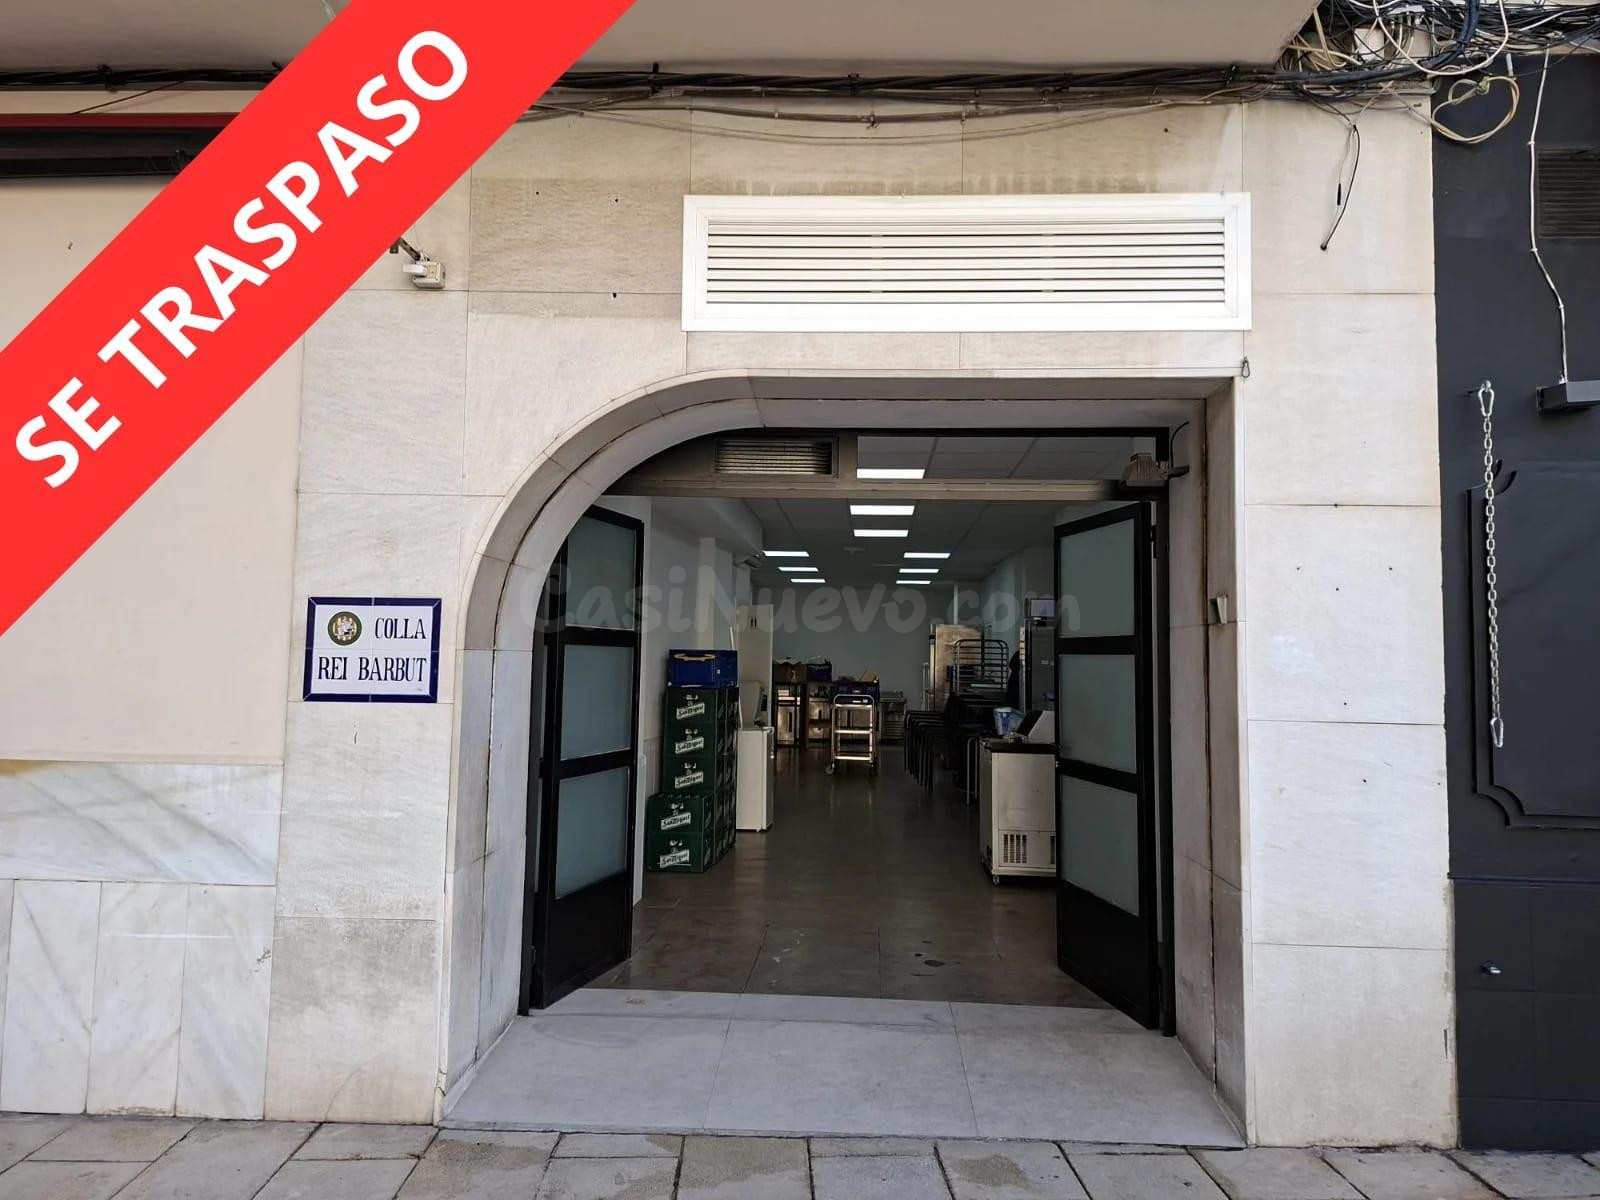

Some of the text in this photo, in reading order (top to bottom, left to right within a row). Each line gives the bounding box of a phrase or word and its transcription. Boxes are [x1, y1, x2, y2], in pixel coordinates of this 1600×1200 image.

[374, 617, 427, 640] COLLA
[318, 656, 427, 682] REI BARBUT
